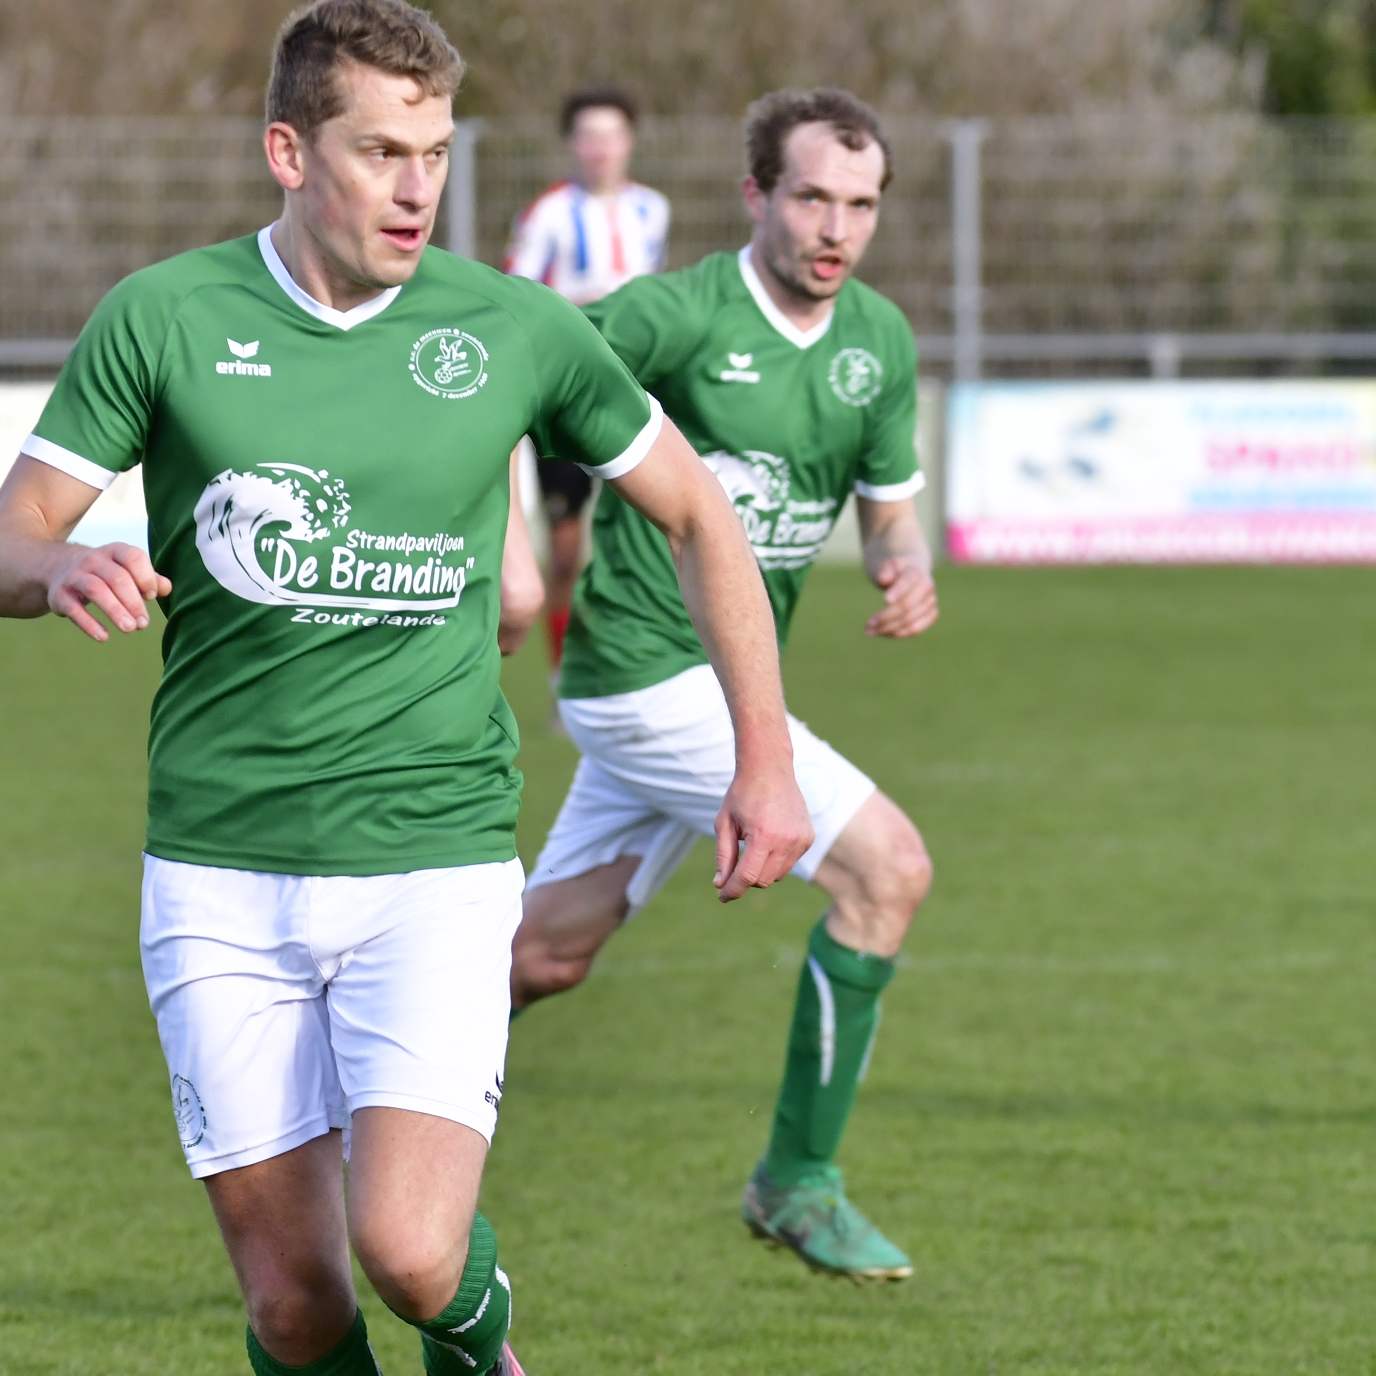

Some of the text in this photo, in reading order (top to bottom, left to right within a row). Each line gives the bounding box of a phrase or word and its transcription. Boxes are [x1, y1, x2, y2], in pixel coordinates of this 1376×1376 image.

[215, 359, 272, 377] erima
[345, 529, 464, 557] Strandpaviljoen
[290, 608, 446, 627] Zoutelande
